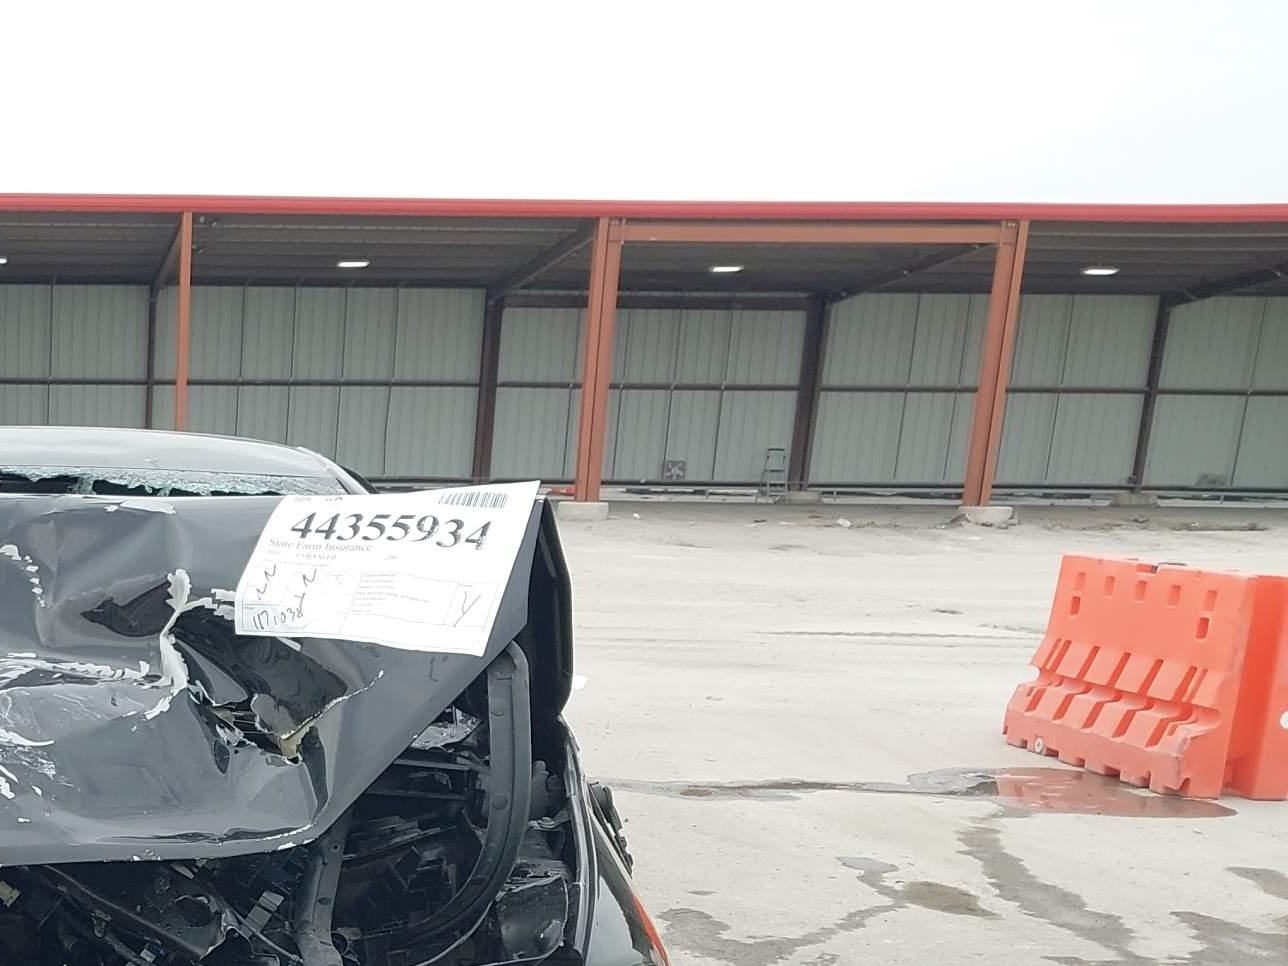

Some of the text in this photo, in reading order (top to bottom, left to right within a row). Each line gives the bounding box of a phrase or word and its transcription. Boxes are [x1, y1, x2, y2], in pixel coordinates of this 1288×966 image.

[290, 511, 492, 551] 44355934
[268, 538, 373, 553] State Farm Insurance
